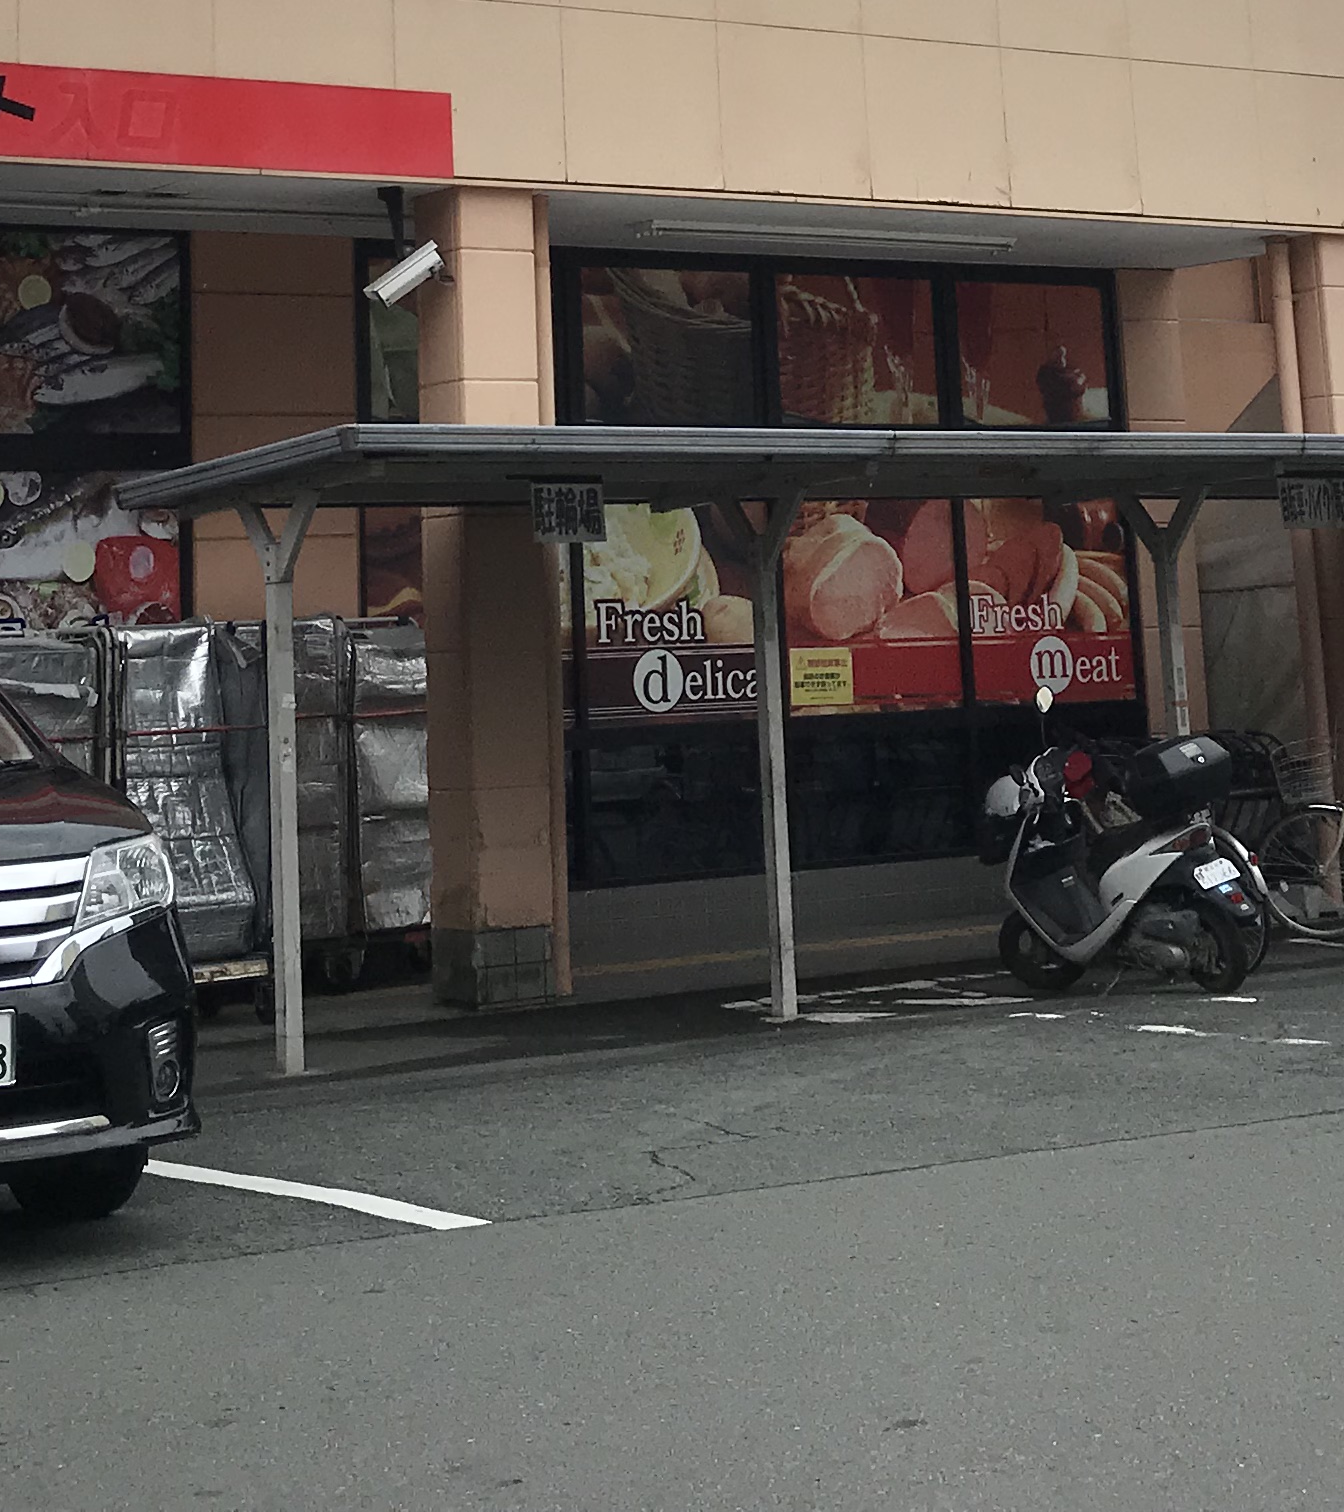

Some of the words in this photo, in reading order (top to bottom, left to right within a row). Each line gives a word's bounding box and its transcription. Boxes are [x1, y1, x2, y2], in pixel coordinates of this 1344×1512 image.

[596, 600, 705, 643] Fresh
[970, 594, 1064, 633] Fresh
[1035, 647, 1122, 683] meat
